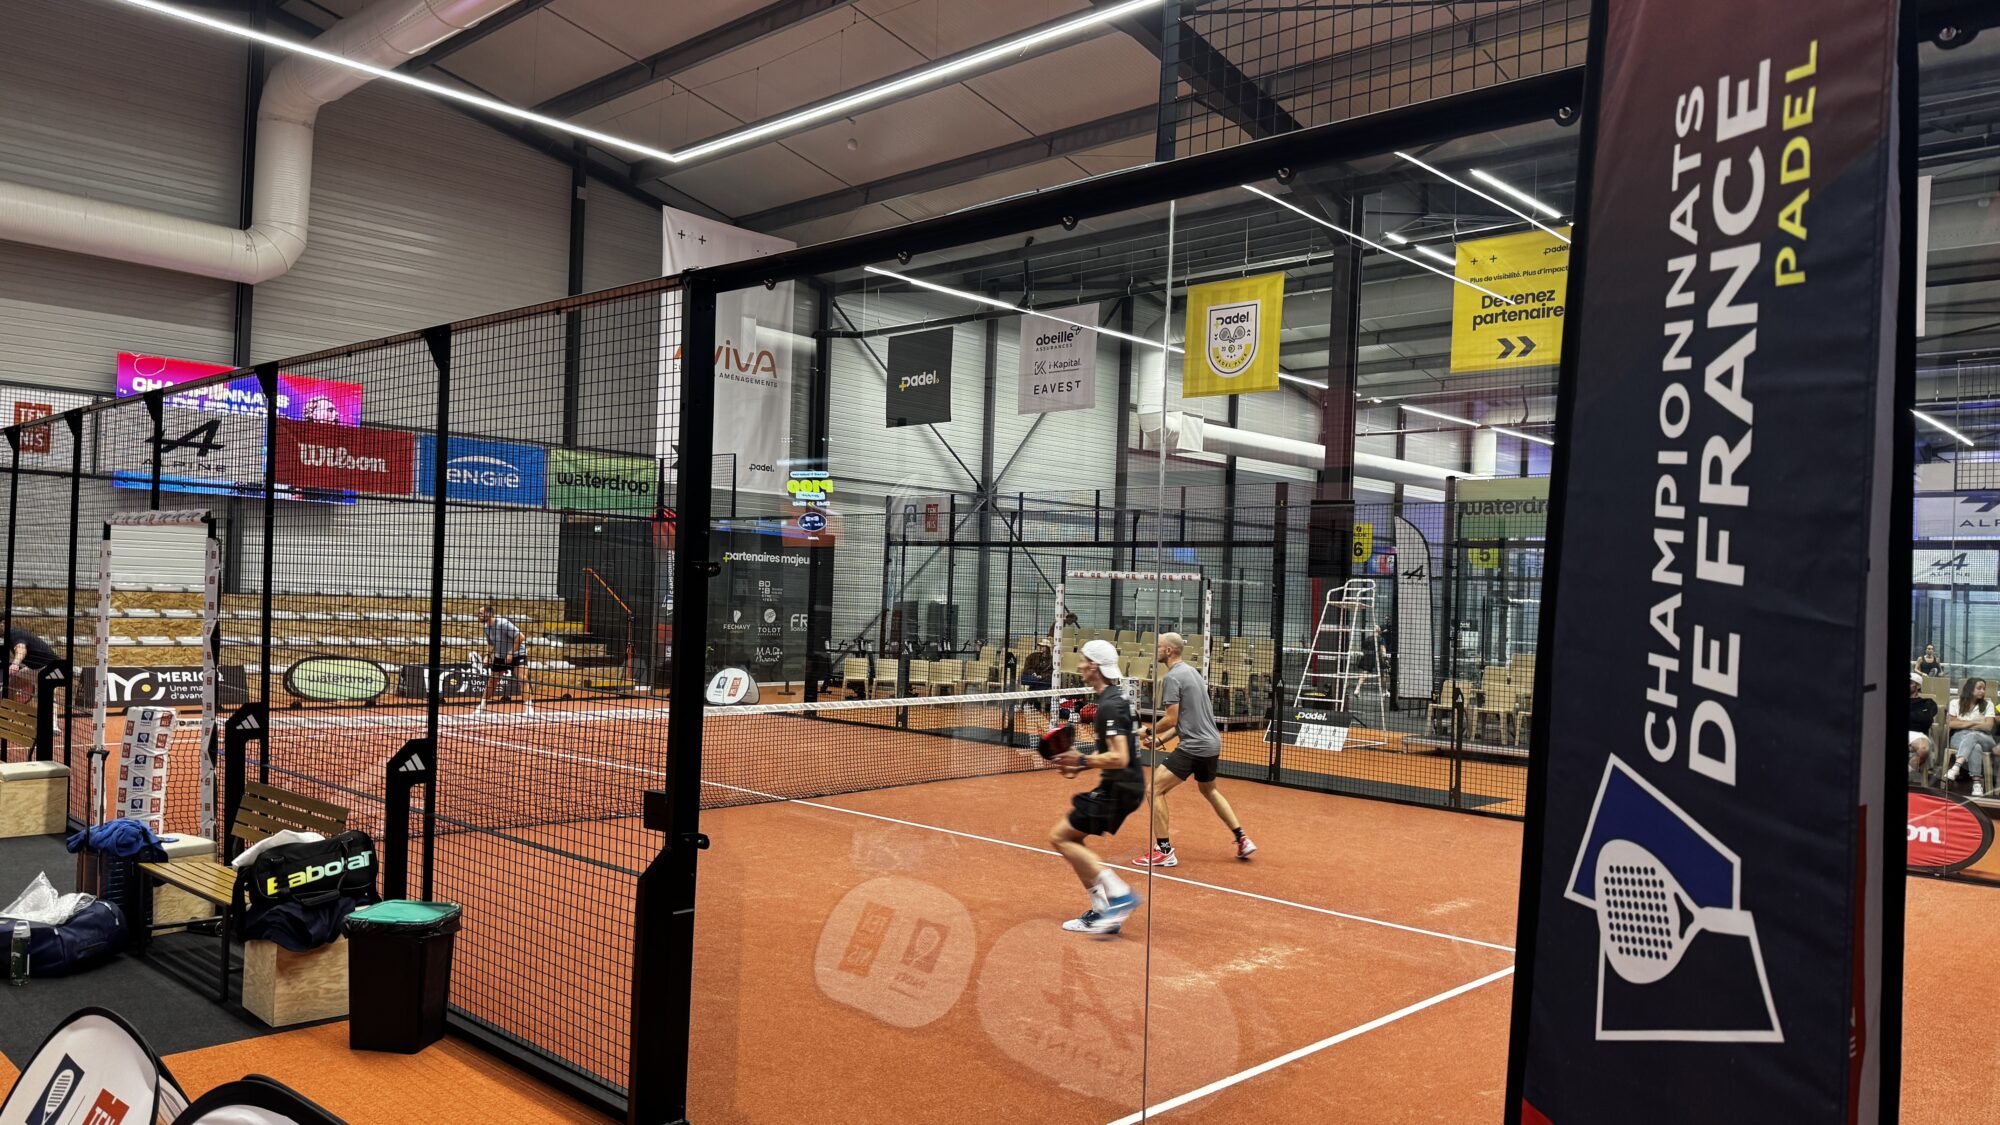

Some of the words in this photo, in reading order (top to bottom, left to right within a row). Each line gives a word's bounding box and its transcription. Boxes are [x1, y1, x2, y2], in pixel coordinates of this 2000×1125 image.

[1775, 39, 1819, 287] PADEL
[1482, 289, 1556, 309] Devenez
[1472, 303, 1565, 331] partenaire
[1696, 58, 1772, 587] FRANCE
[1036, 331, 1074, 346] abeille
[1033, 380, 1081, 395] EAVEST
[1644, 84, 1705, 763] CHAMPIONNATS
[142, 458, 226, 472] APINE
[298, 442, 389, 473] Wilson
[556, 471, 650, 496] waterdrop
[1464, 496, 1548, 516] waterdr
[1354, 541, 1364, 557] 6
[725, 552, 780, 563] partenaires
[780, 554, 810, 567] majeu
[157, 671, 224, 682] MERI
[1688, 624, 1741, 787] DE
